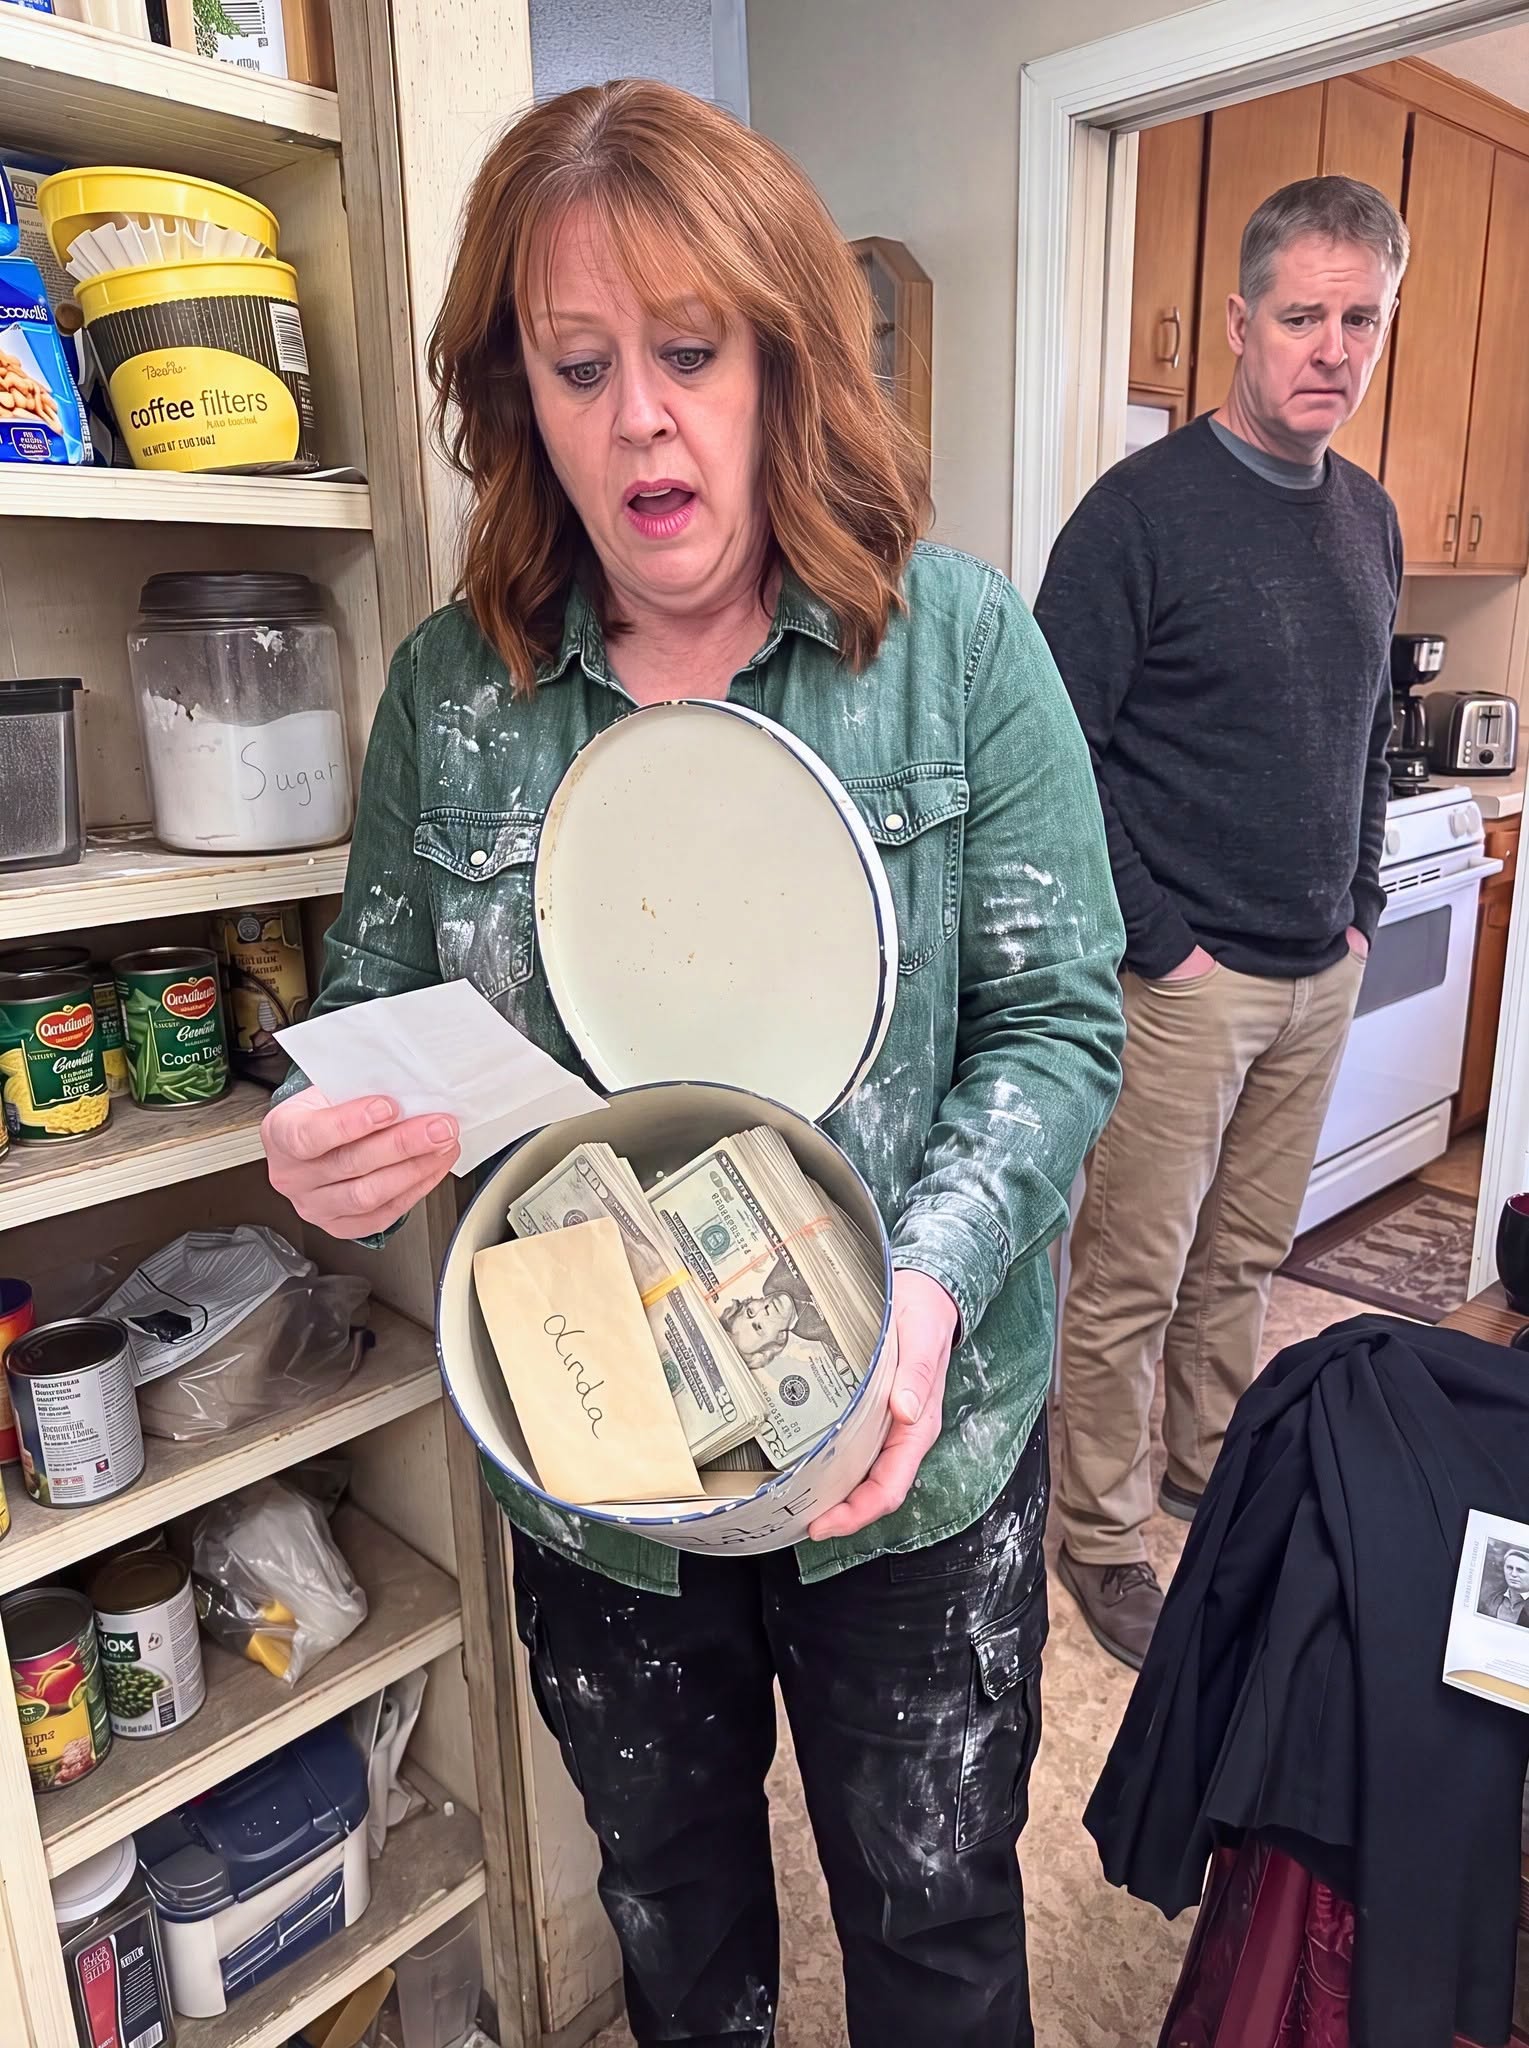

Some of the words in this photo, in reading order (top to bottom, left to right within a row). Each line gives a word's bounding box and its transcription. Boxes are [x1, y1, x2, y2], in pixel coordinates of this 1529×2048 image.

[130, 396, 195, 430] coffee
[200, 388, 268, 416] filters
[240, 741, 339, 806] Sugar
[543, 1314, 605, 1440] Linda
[714, 1384, 738, 1423] 20
